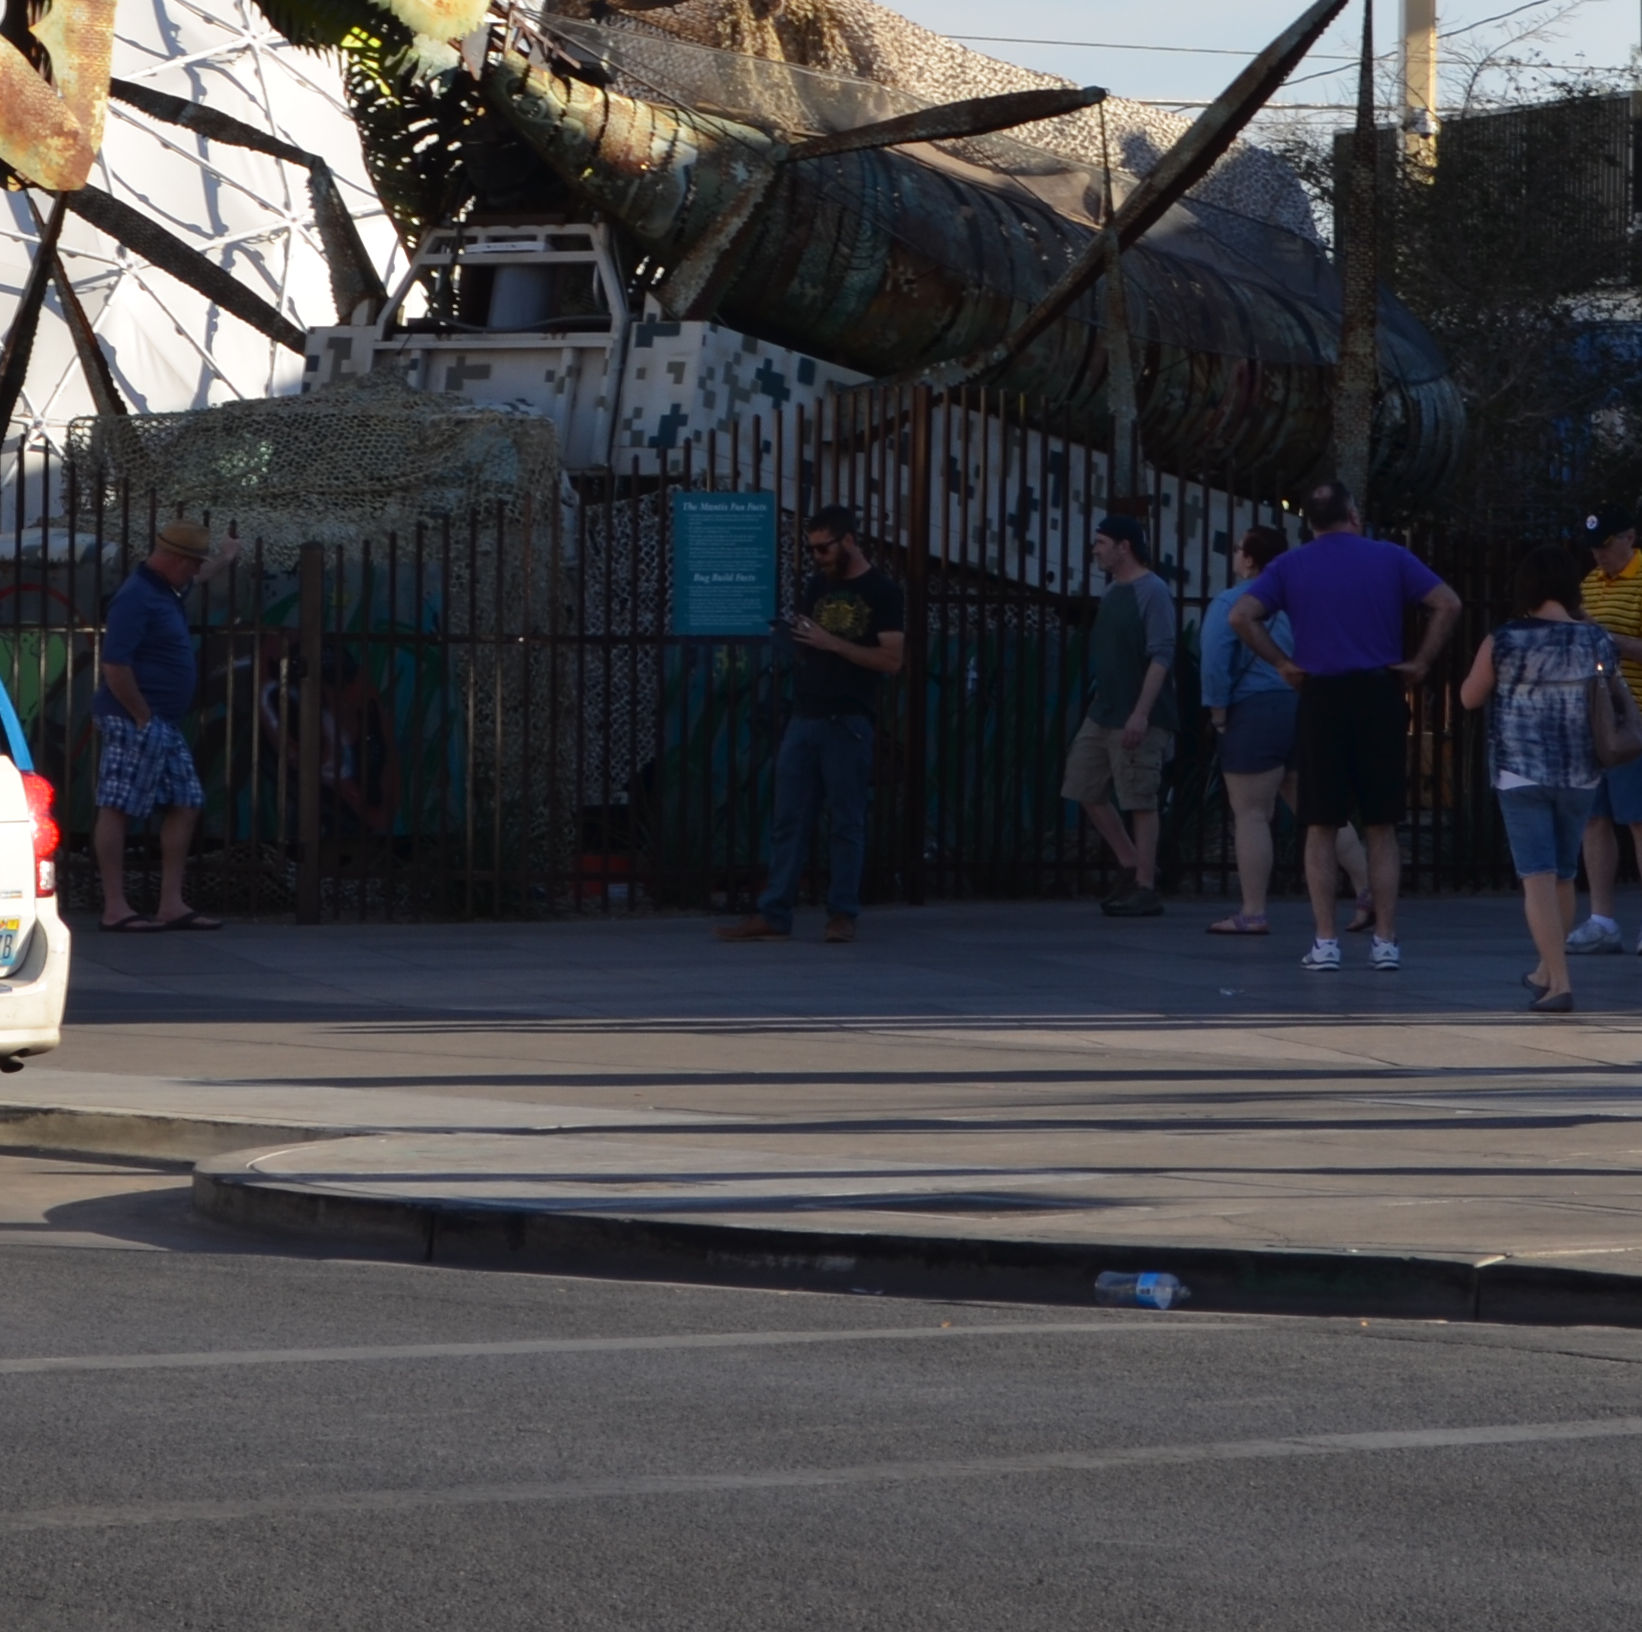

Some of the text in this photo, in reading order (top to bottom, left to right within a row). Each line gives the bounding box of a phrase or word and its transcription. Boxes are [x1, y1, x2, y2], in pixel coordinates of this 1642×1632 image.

[682, 501, 698, 512] The
[699, 501, 728, 512] Mantis
[730, 501, 745, 512] Fun
[692, 572, 710, 584] Bug
[711, 572, 734, 582] Build
